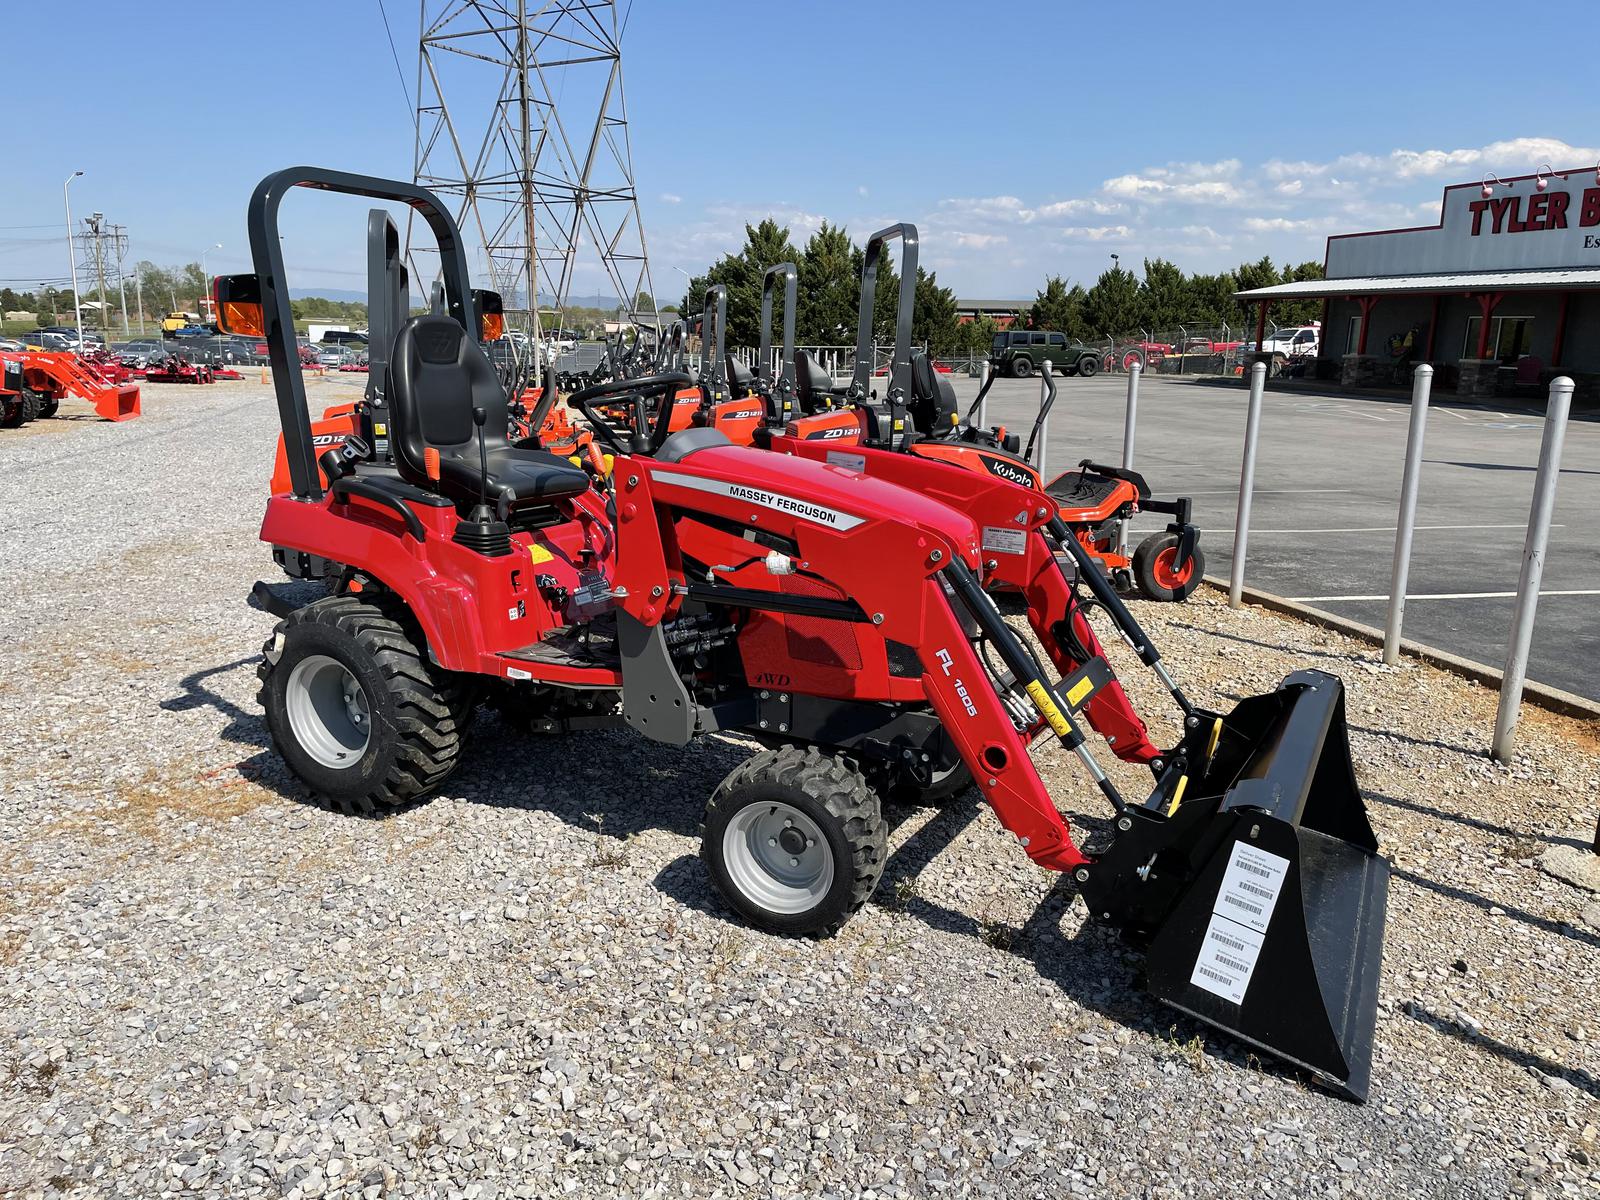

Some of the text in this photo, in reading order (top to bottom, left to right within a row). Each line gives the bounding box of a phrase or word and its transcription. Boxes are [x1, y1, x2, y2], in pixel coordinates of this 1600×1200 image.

[1469, 187, 1600, 236] TYLER B
[993, 461, 1032, 488] Kubota
[729, 486, 836, 524] MASSEY FERGUSON
[754, 672, 791, 686] 4WD
[935, 648, 978, 717] FL 1805
